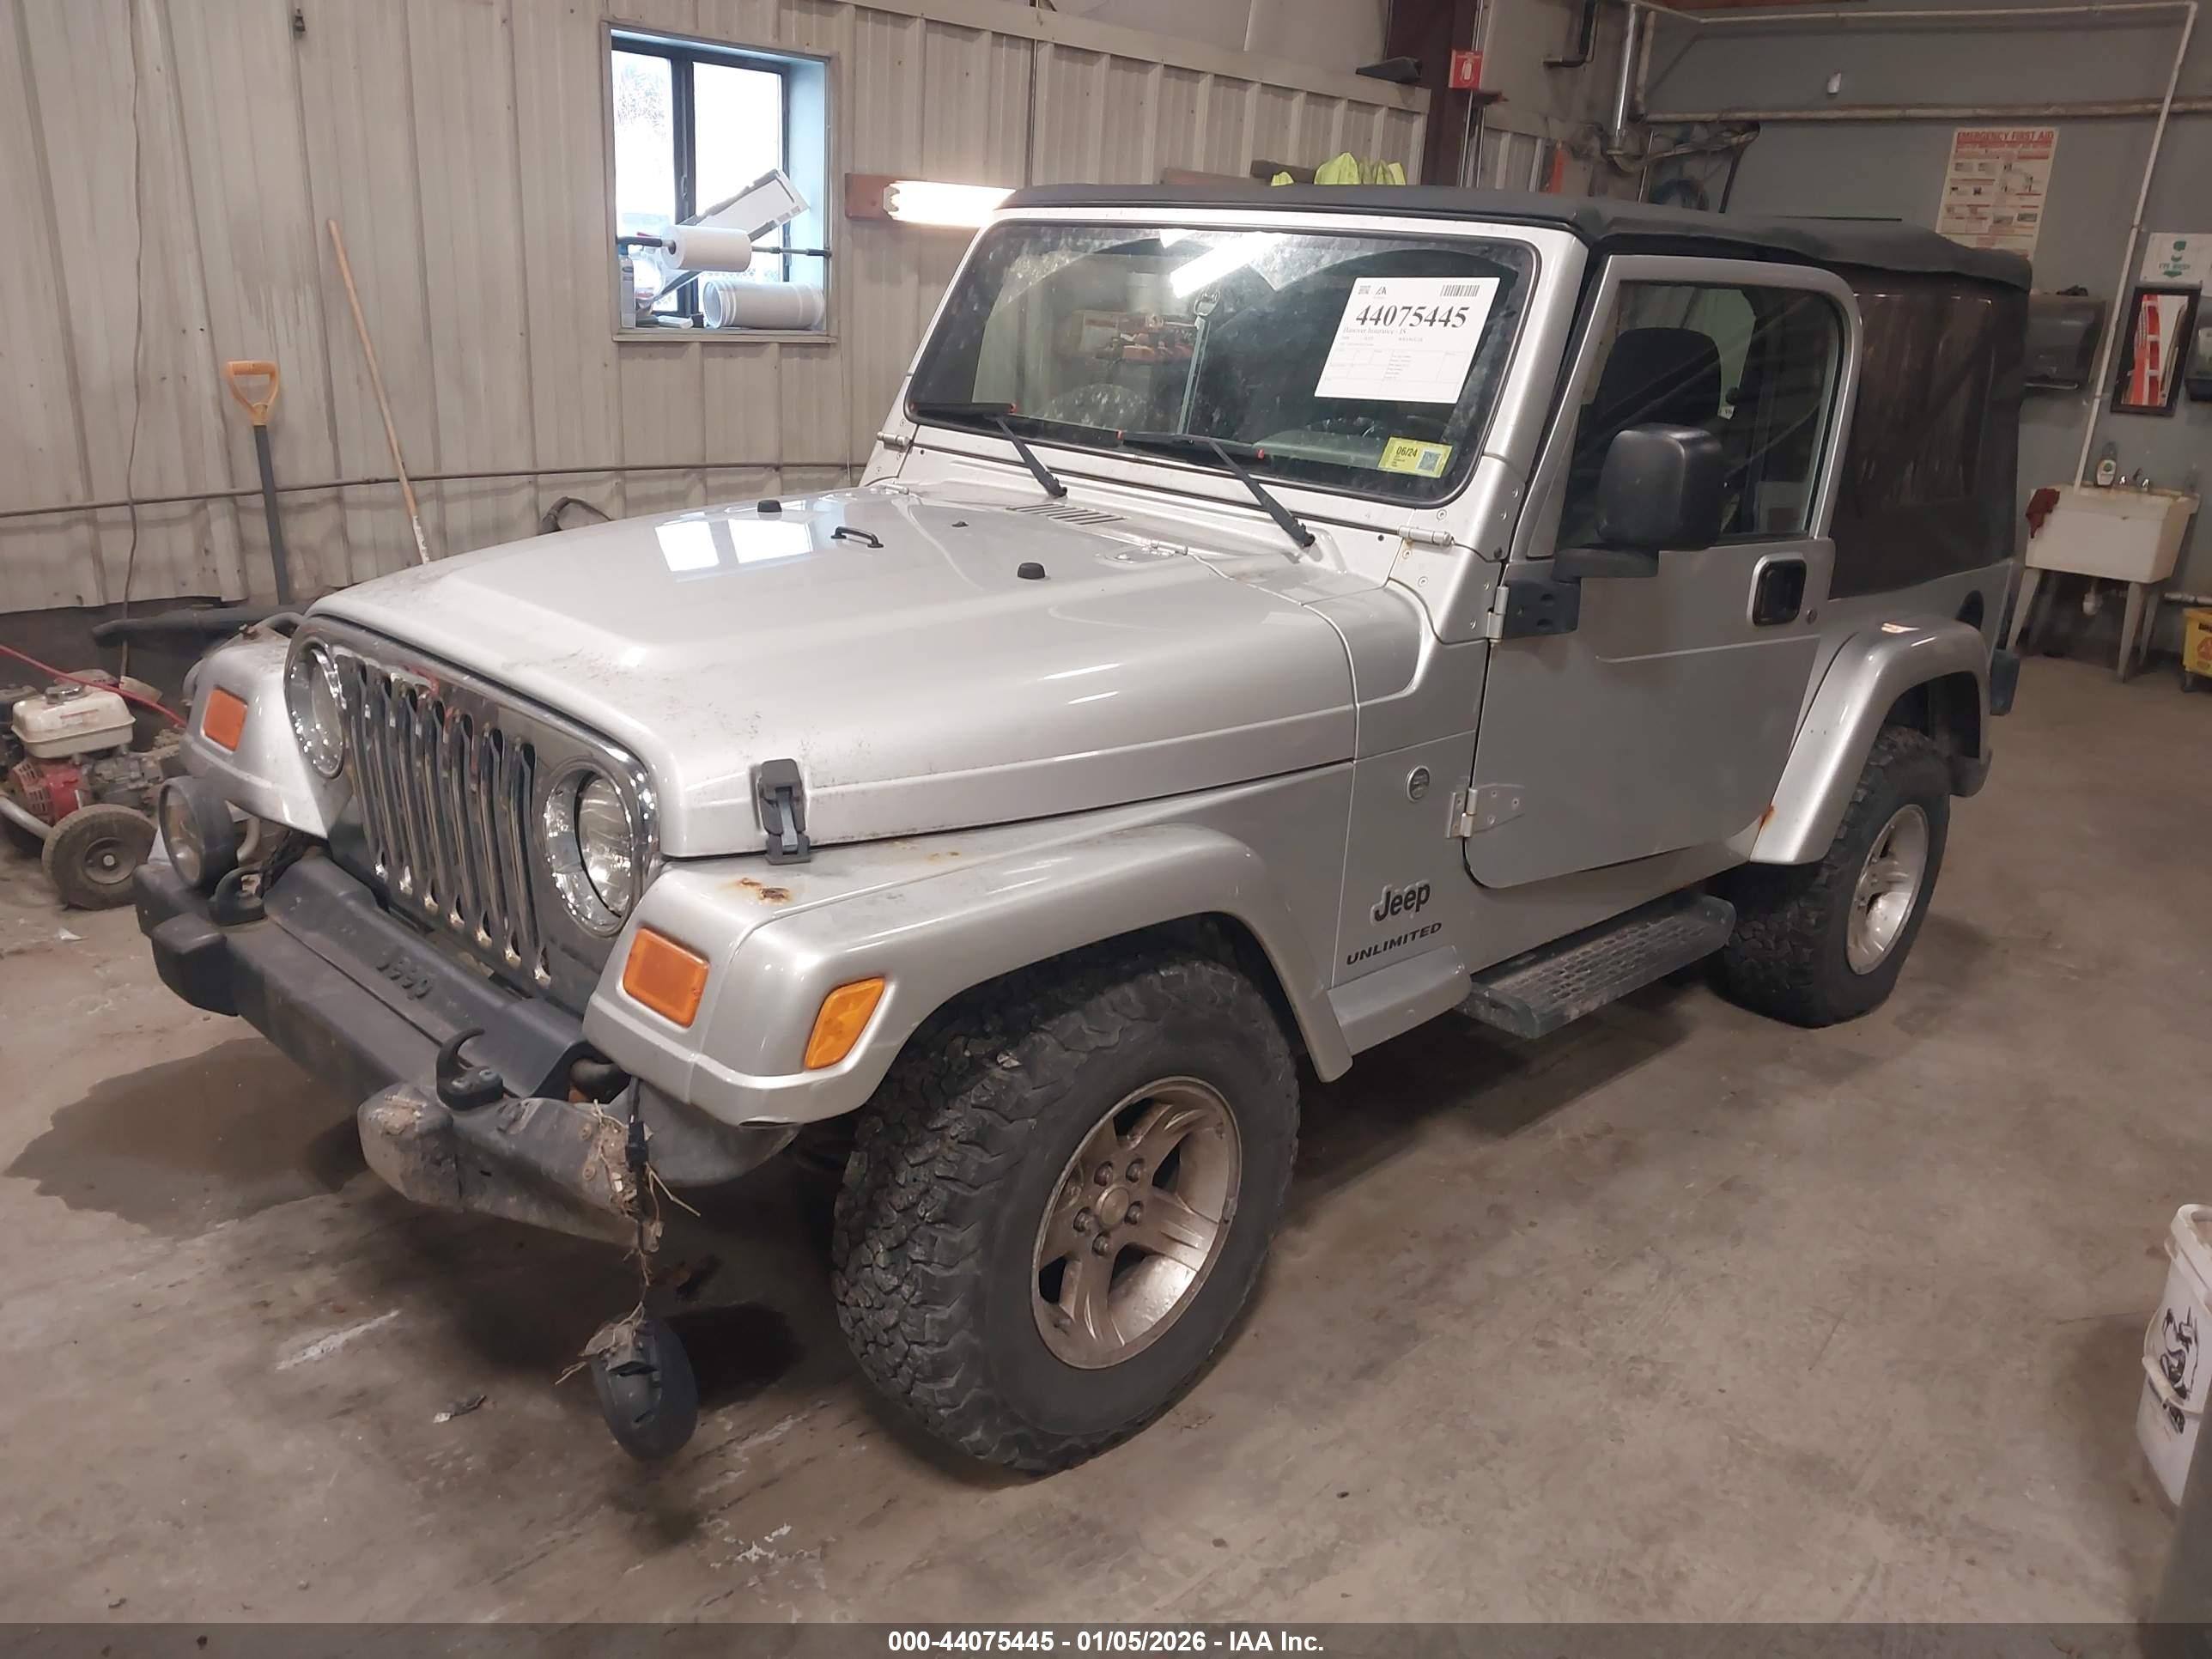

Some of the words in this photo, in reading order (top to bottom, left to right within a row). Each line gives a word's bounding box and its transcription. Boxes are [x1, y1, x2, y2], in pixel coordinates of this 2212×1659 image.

[2038, 131, 2055, 140] AID
[1356, 304, 1471, 328] 44075445
[1396, 446, 1419, 458] 06/24
[1373, 880, 1431, 922] Jeep
[1346, 922, 1443, 965] UNLIMITED
